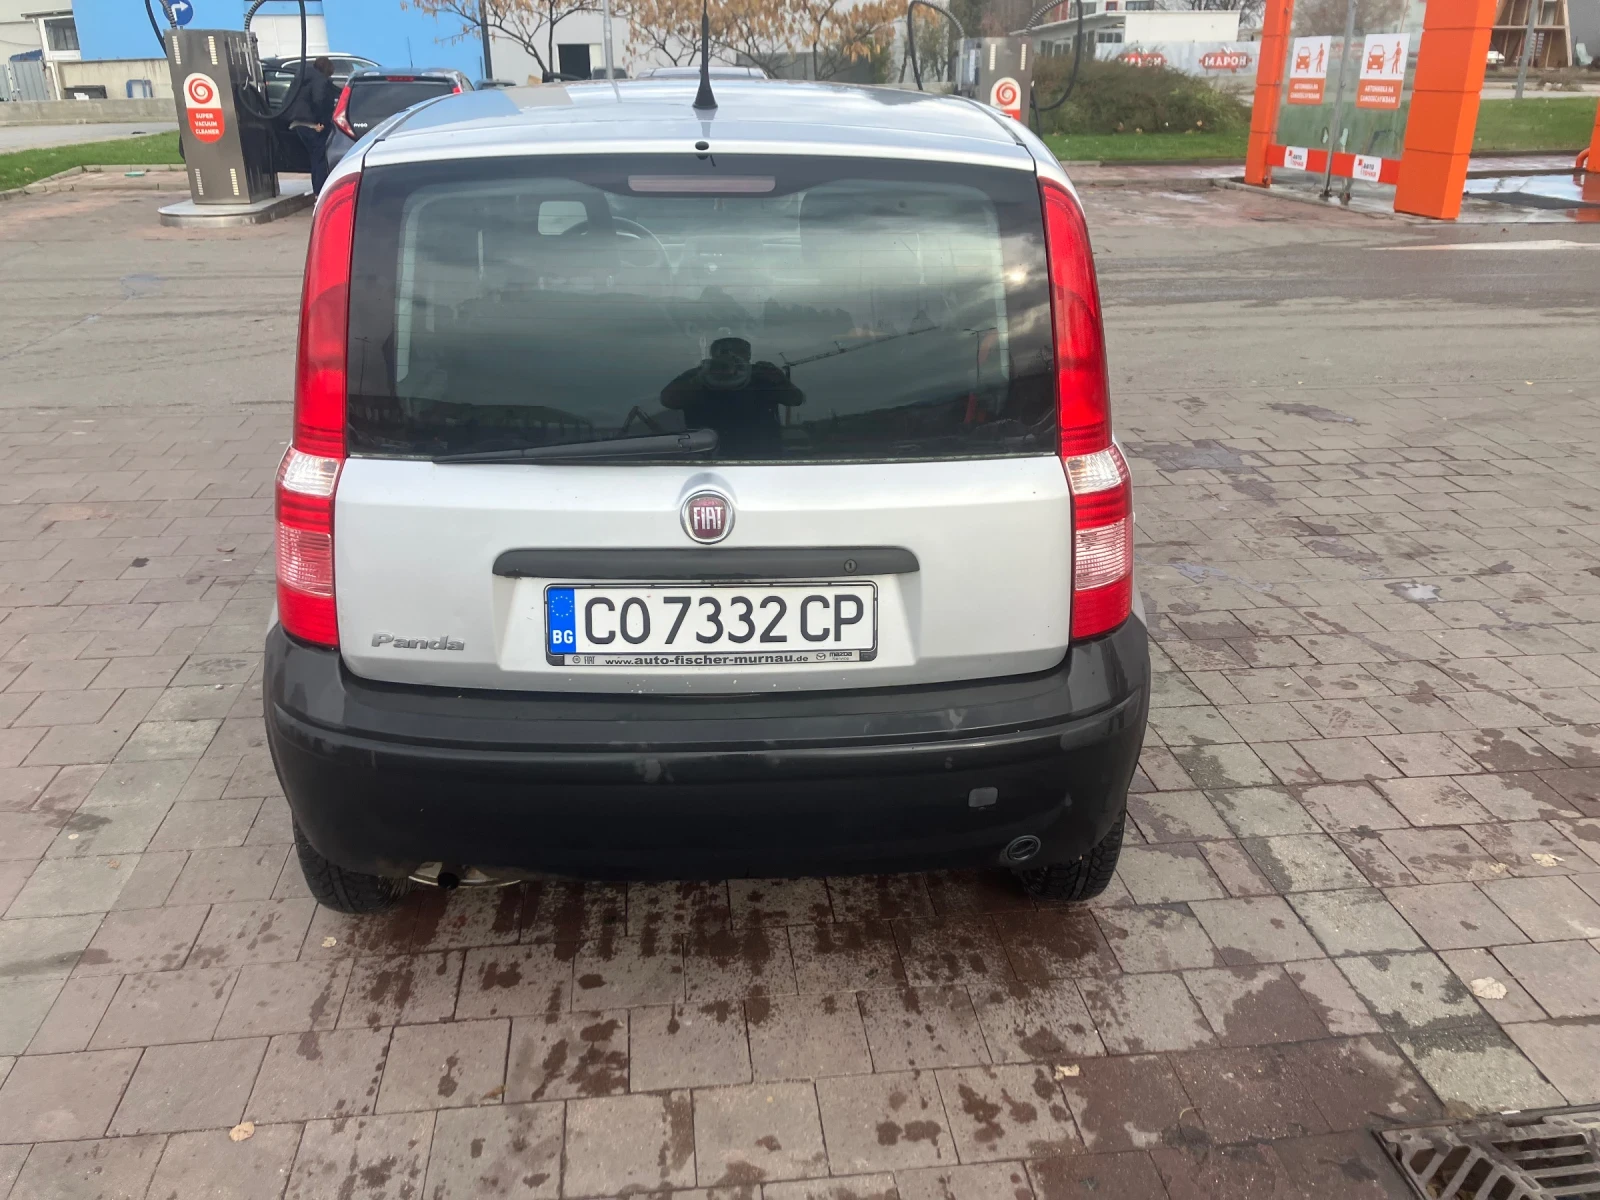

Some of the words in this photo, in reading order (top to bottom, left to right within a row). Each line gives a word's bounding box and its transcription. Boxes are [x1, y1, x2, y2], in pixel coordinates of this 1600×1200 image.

[693, 506, 724, 530] FIAT
[663, 596, 788, 644] 7332
[800, 594, 864, 642] CP
[371, 632, 465, 651] Panda
[552, 629, 574, 644] BG
[584, 655, 595, 664] FIAT
[604, 654, 809, 665] www.auto-fischer-murnau.de
